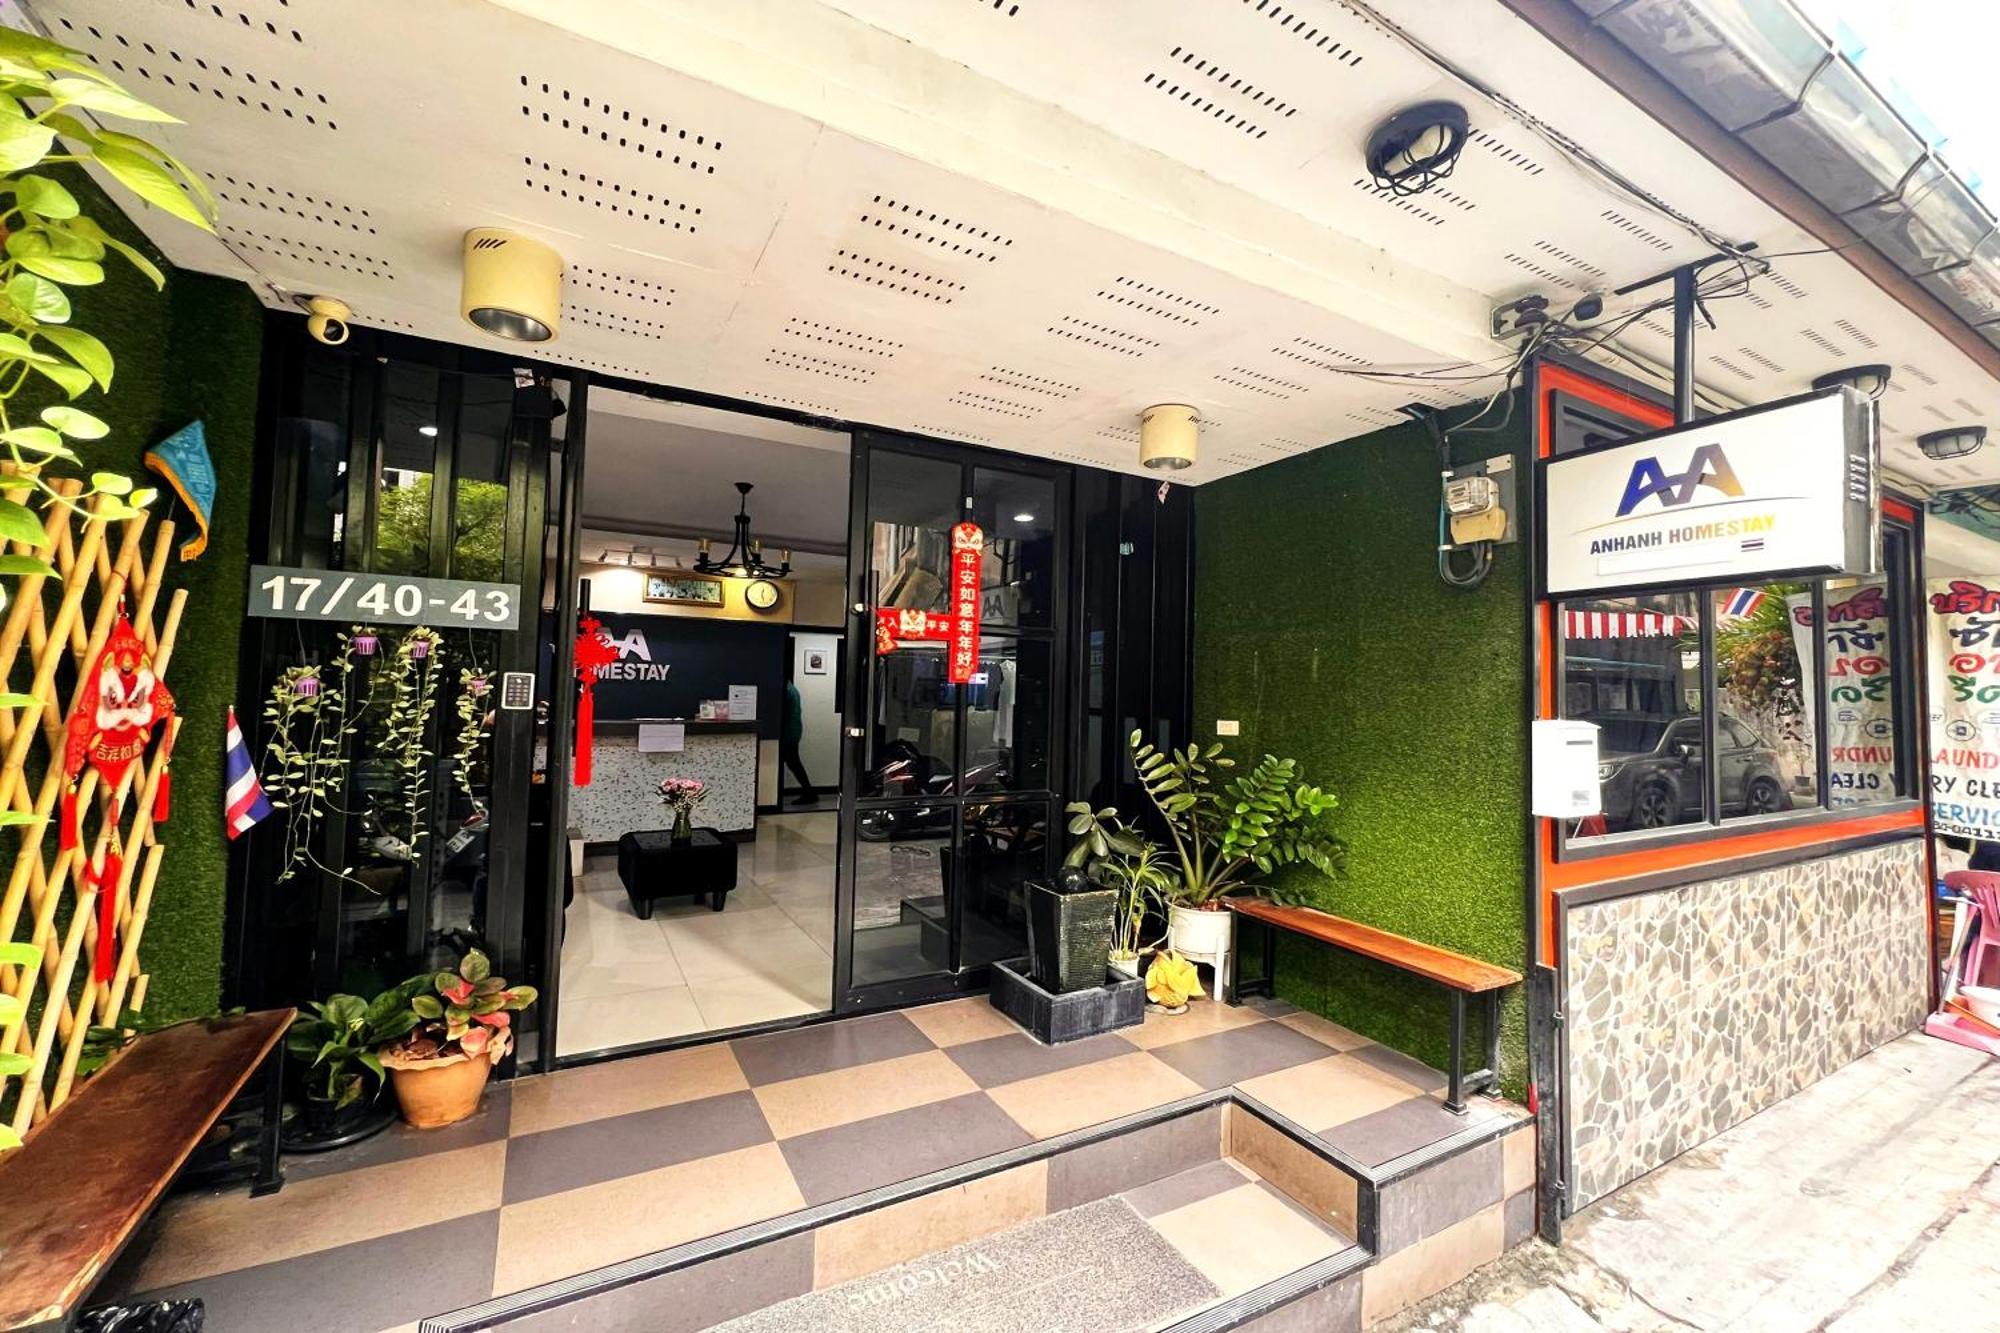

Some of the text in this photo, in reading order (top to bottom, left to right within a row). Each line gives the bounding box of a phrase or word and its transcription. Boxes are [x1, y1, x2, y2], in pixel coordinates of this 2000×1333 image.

[1590, 513, 1775, 555] ANHANH HOMESTAY
[262, 575, 510, 622] 17/40-43
[957, 553, 976, 666] 平安如意年年好
[574, 662, 671, 681] MESTAY
[1931, 774, 1957, 793] RY
